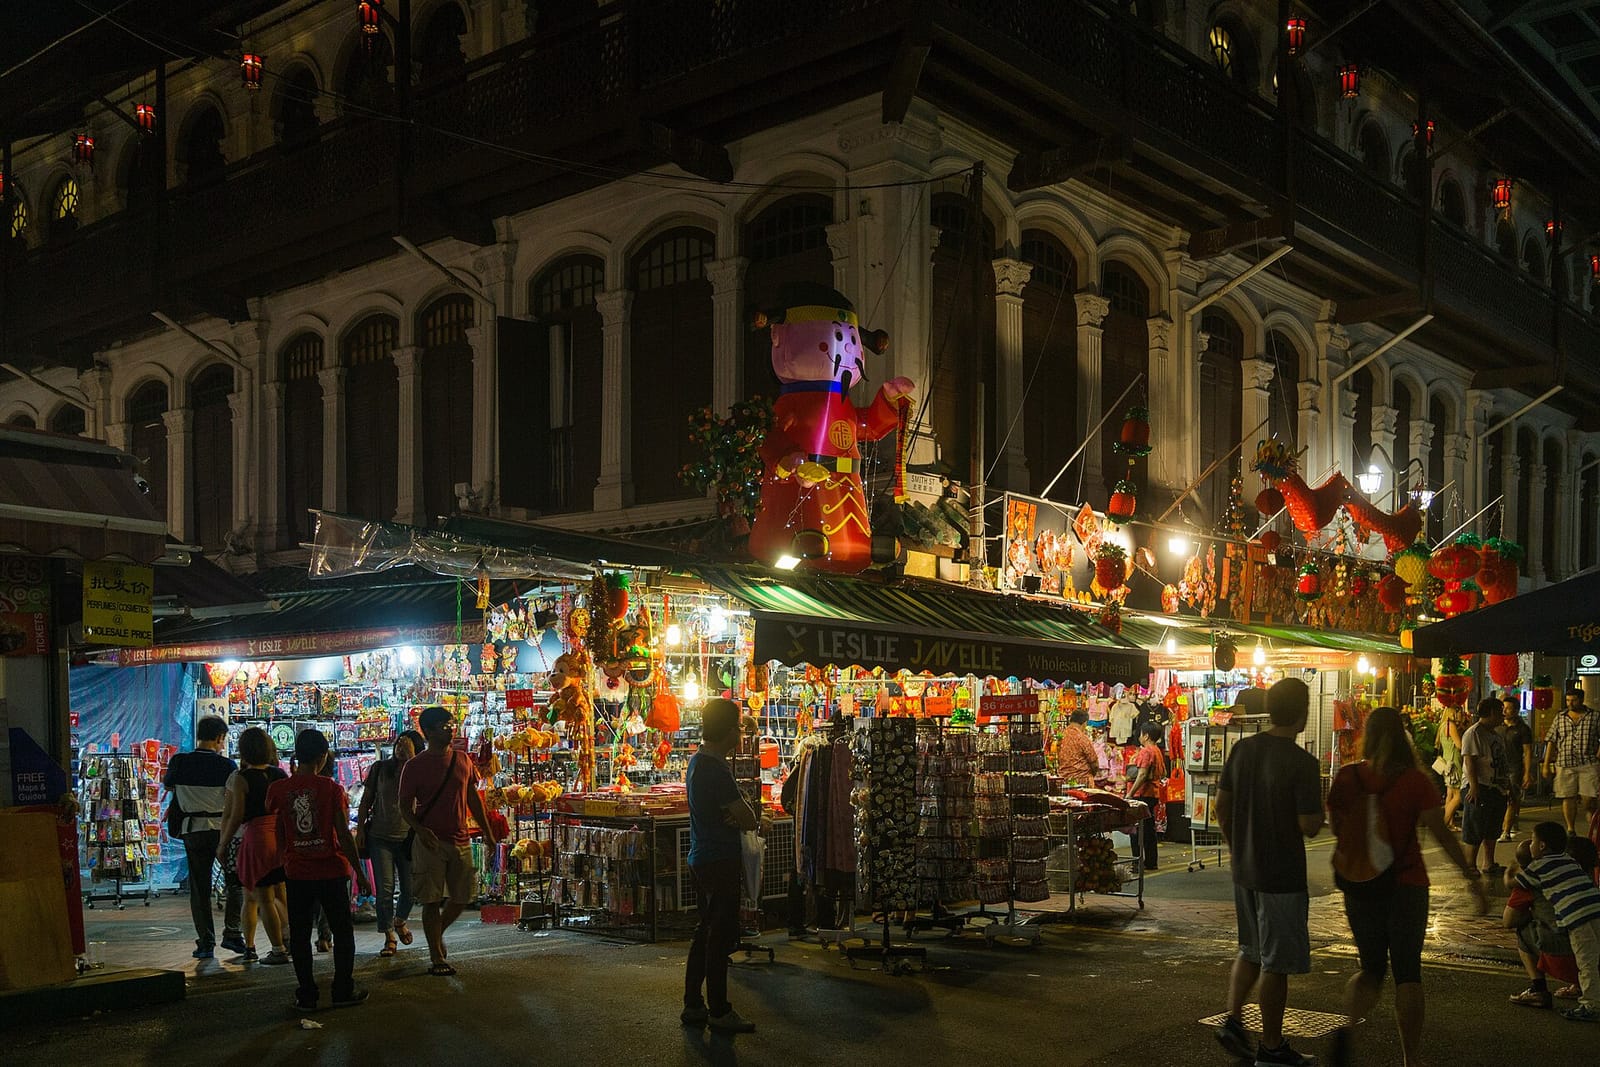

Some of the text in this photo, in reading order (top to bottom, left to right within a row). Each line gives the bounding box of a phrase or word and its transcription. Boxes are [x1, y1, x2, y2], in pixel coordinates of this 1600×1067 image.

[911, 474, 928, 484] SMITH
[91, 576, 149, 595] 批发价
[33, 612, 46, 655] TICKETS
[84, 625, 152, 640] WHOLESALE PRICE
[259, 639, 282, 652] LESLIE
[133, 650, 153, 662] LESLIE
[817, 630, 1132, 677] LESLIE JAVELLE Wholesale & Retail
[982, 702, 997, 710] 36
[1016, 700, 1036, 709] $10
[16, 773, 47, 783] FREE
[18, 783, 46, 793] Maps &
[18, 793, 47, 801] Guides
